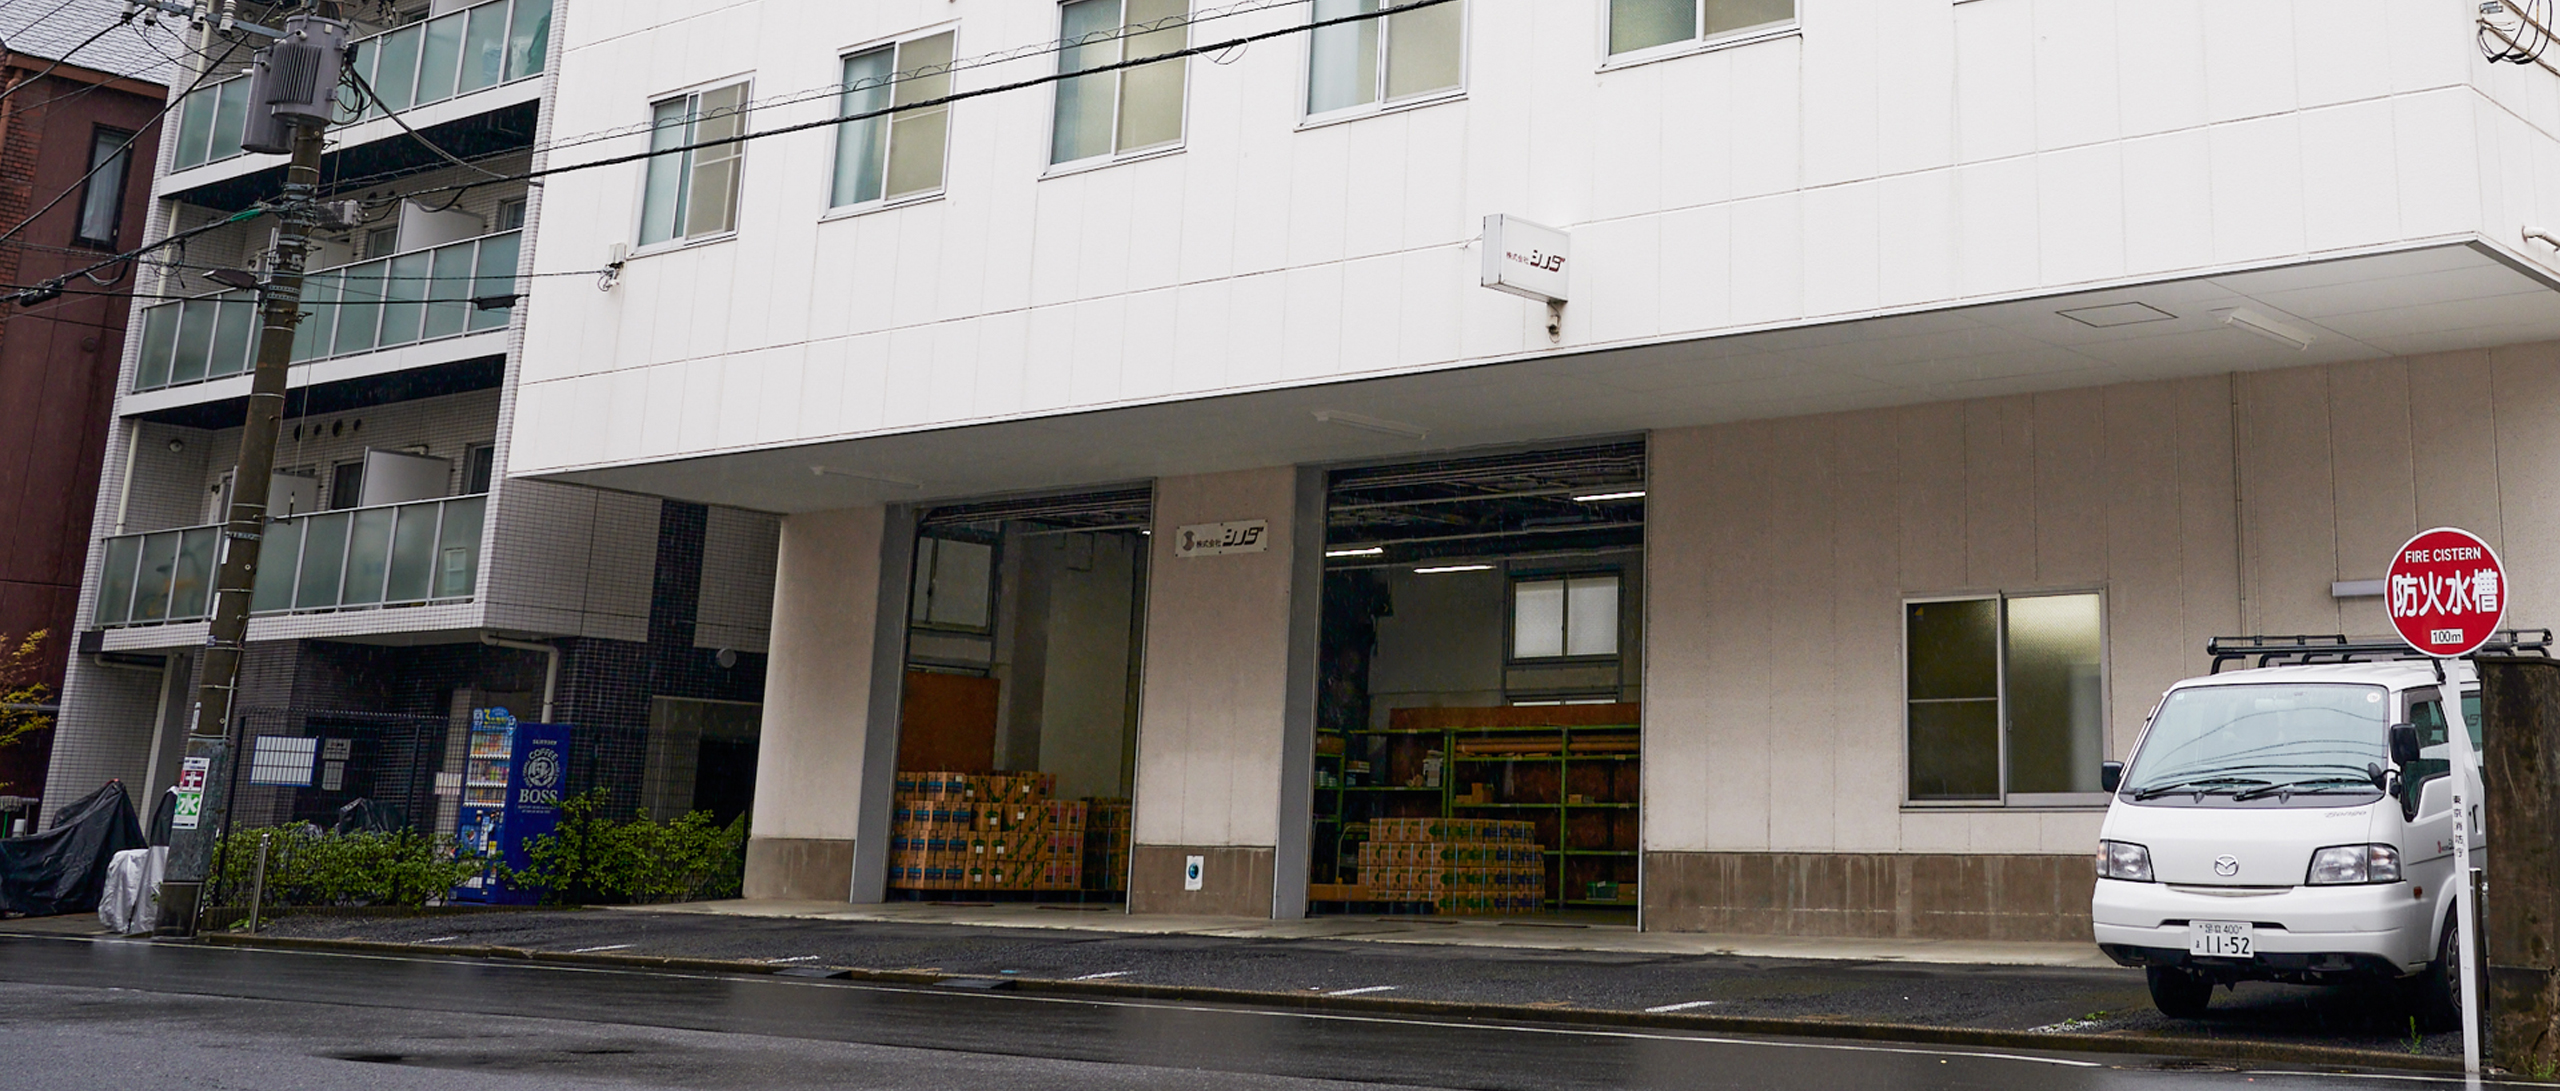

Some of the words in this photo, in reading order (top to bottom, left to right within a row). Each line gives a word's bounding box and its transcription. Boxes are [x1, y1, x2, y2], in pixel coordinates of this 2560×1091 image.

[1530, 249, 1565, 272] シノダ
[1222, 526, 1264, 547] シノダ
[2405, 549, 2430, 563] FIRE
[2433, 547, 2481, 562] CISTERN
[2392, 568, 2498, 618] 防火水槽
[2433, 630, 2461, 642] 100m
[528, 747, 559, 761] COFFEE
[178, 793, 199, 815] 水
[518, 788, 558, 804] BOSS
[2223, 925, 2240, 934] 400
[2206, 935, 2250, 955] 11-52
